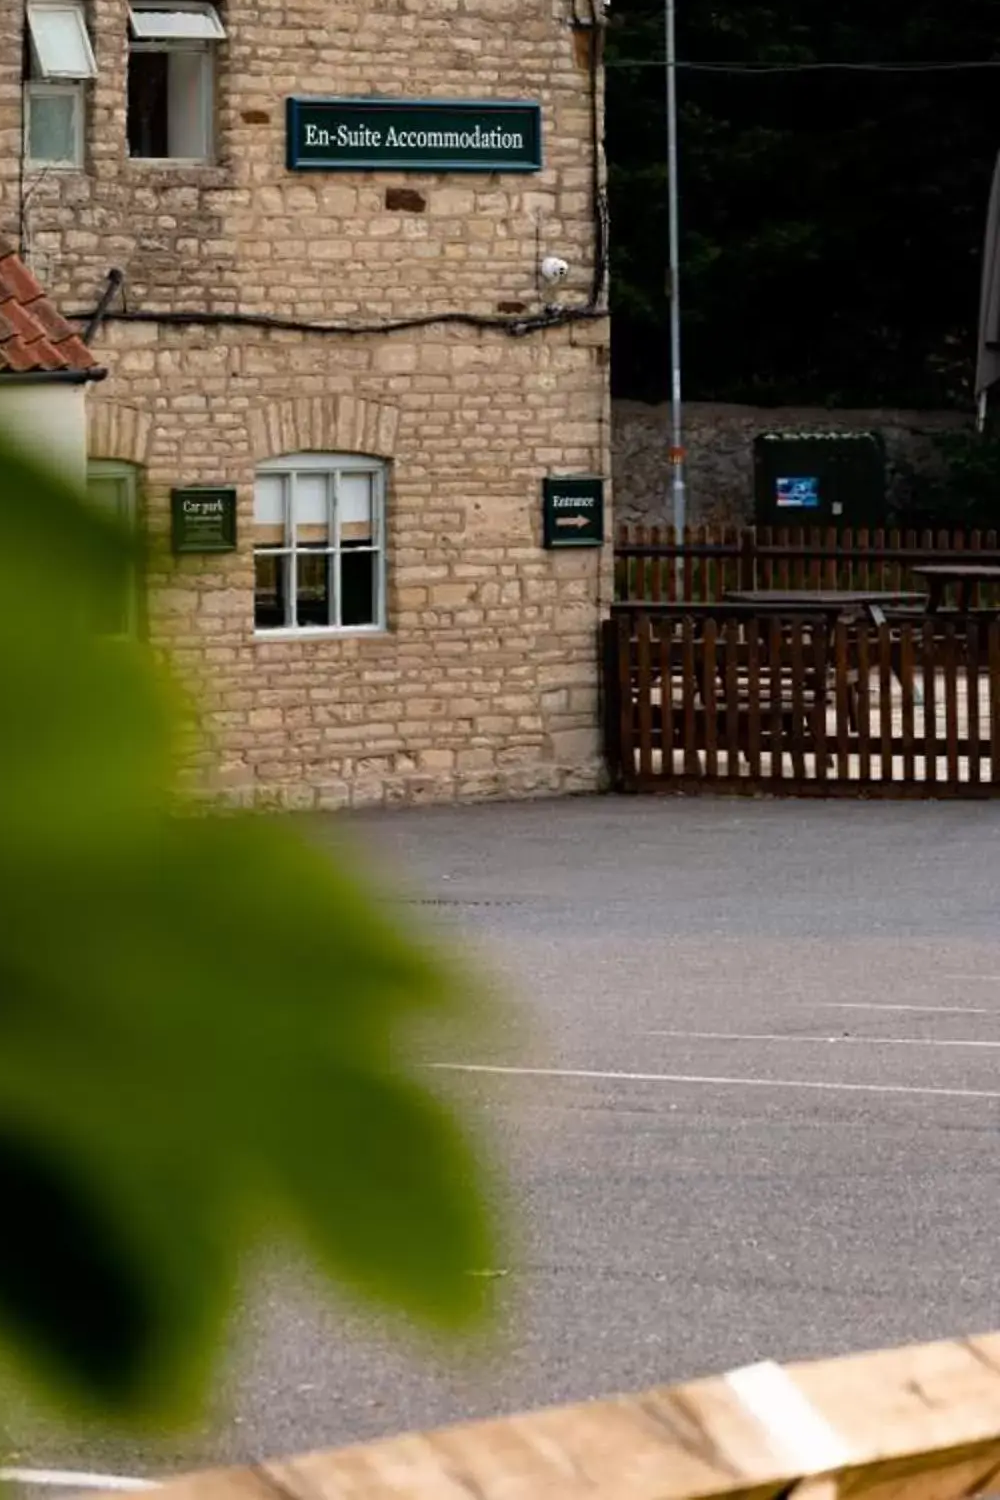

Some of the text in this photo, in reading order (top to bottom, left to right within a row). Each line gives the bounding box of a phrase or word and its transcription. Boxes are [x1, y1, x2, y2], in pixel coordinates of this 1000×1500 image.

[305, 123, 524, 150] En-Suite Accommodation
[183, 500, 200, 513] Car
[552, 494, 595, 508] Entrance
